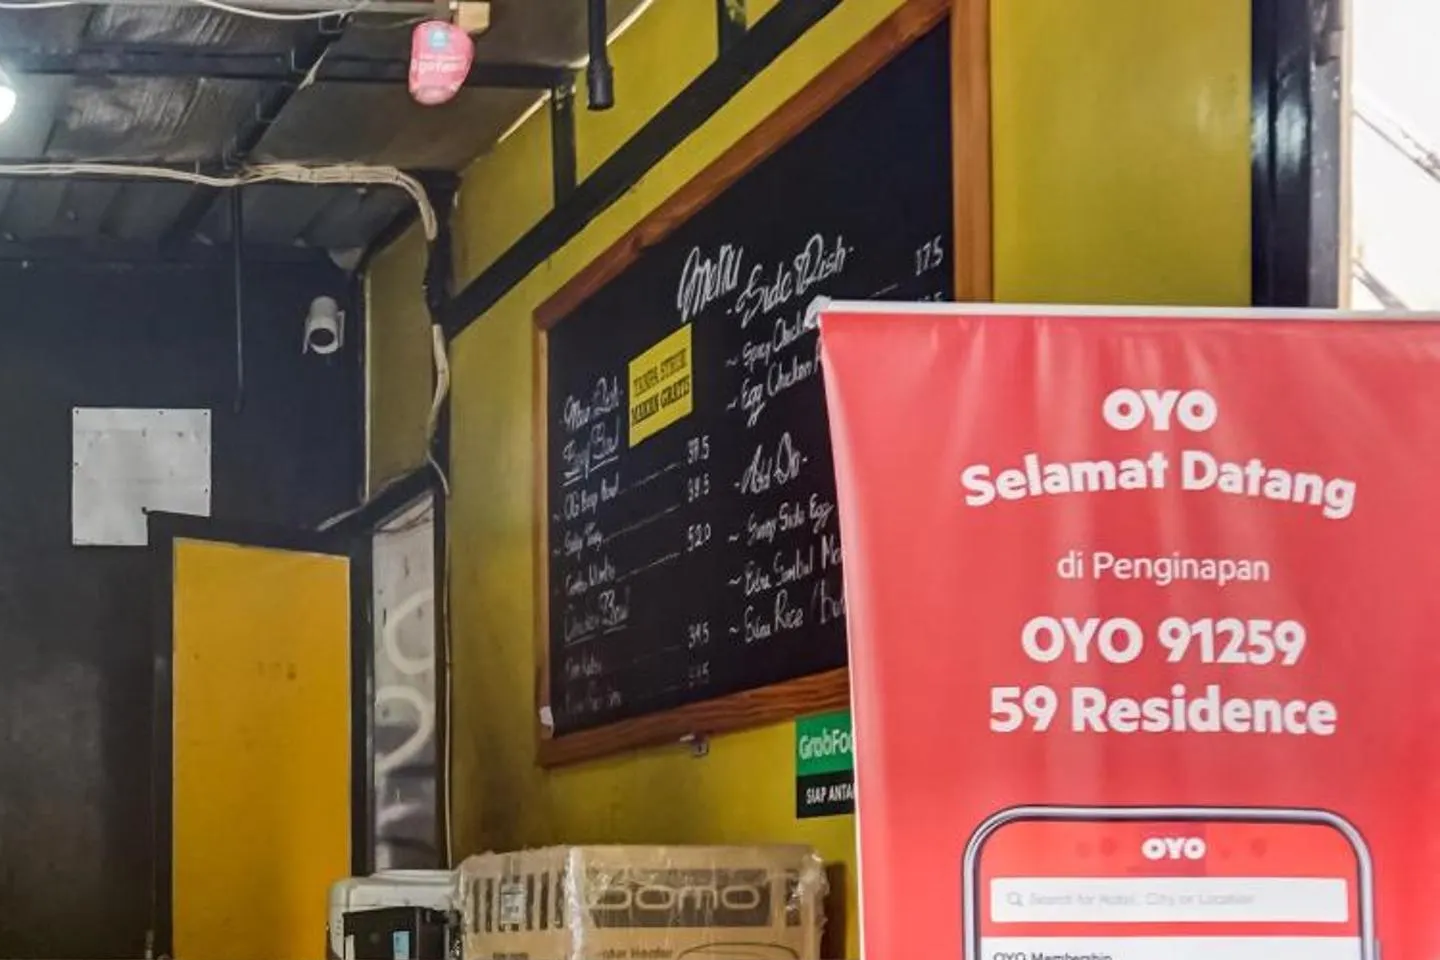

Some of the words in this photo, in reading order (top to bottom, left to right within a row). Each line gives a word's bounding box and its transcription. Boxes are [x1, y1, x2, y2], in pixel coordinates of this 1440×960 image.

[1102, 387, 1217, 431] OYO
[961, 452, 1168, 507] Selamat
[1182, 450, 1356, 519] Datang
[1057, 551, 1083, 579] di
[1094, 552, 1270, 587] Penginapan
[1021, 616, 1143, 664] OYO
[1158, 616, 1307, 665] 91259
[990, 685, 1057, 733] 59
[1072, 684, 1337, 735] Residence
[829, 783, 854, 802] ANTA
[1142, 836, 1207, 860] OYO
